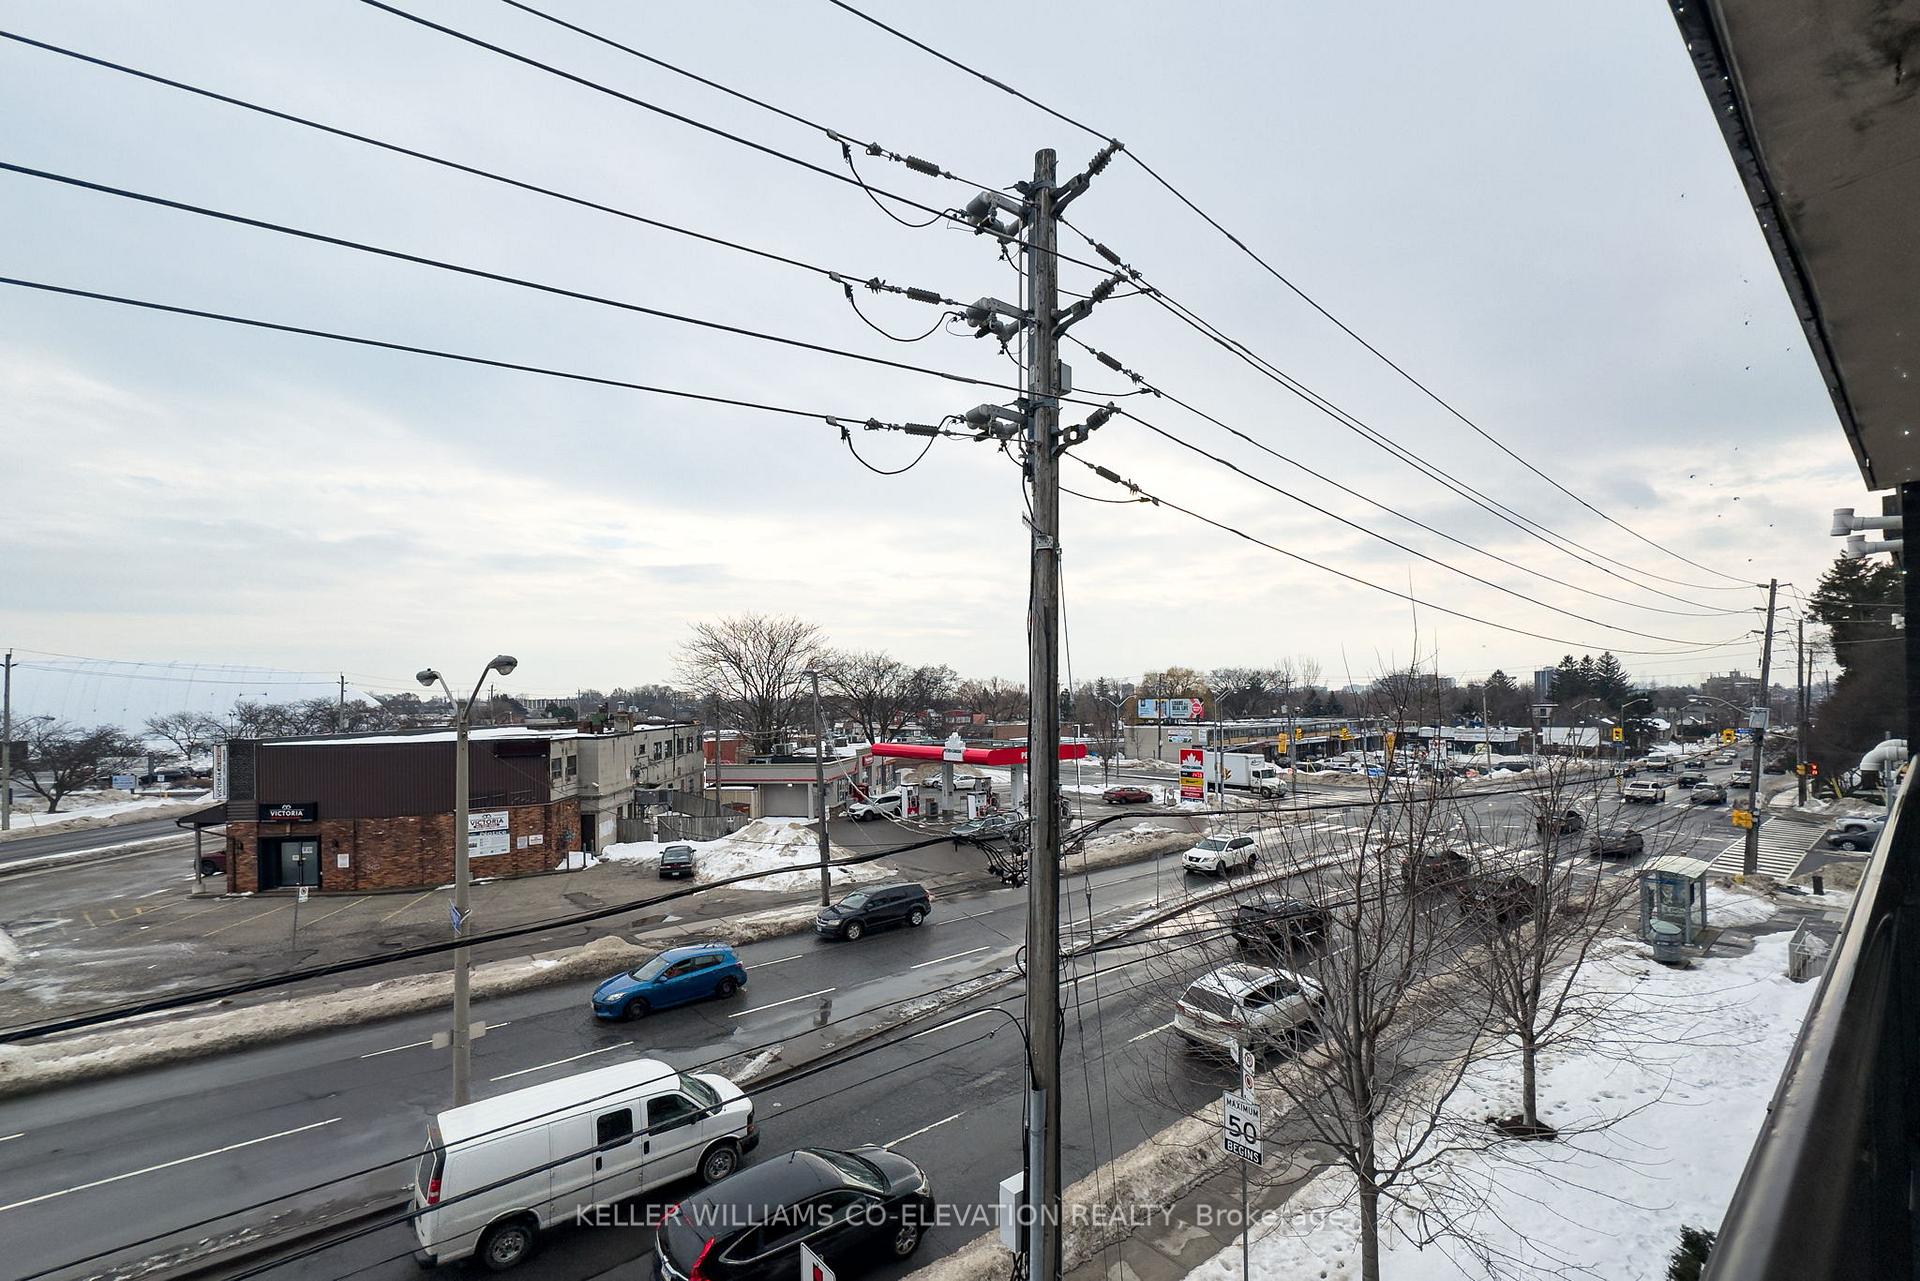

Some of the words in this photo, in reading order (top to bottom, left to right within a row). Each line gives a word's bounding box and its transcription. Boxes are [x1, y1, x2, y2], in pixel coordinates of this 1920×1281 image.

[470, 818, 504, 826] VICTORIA
[1226, 1097, 1259, 1118] MAXIMUM
[1229, 1114, 1257, 1145] 50
[1226, 1138, 1260, 1163] BEGINS
